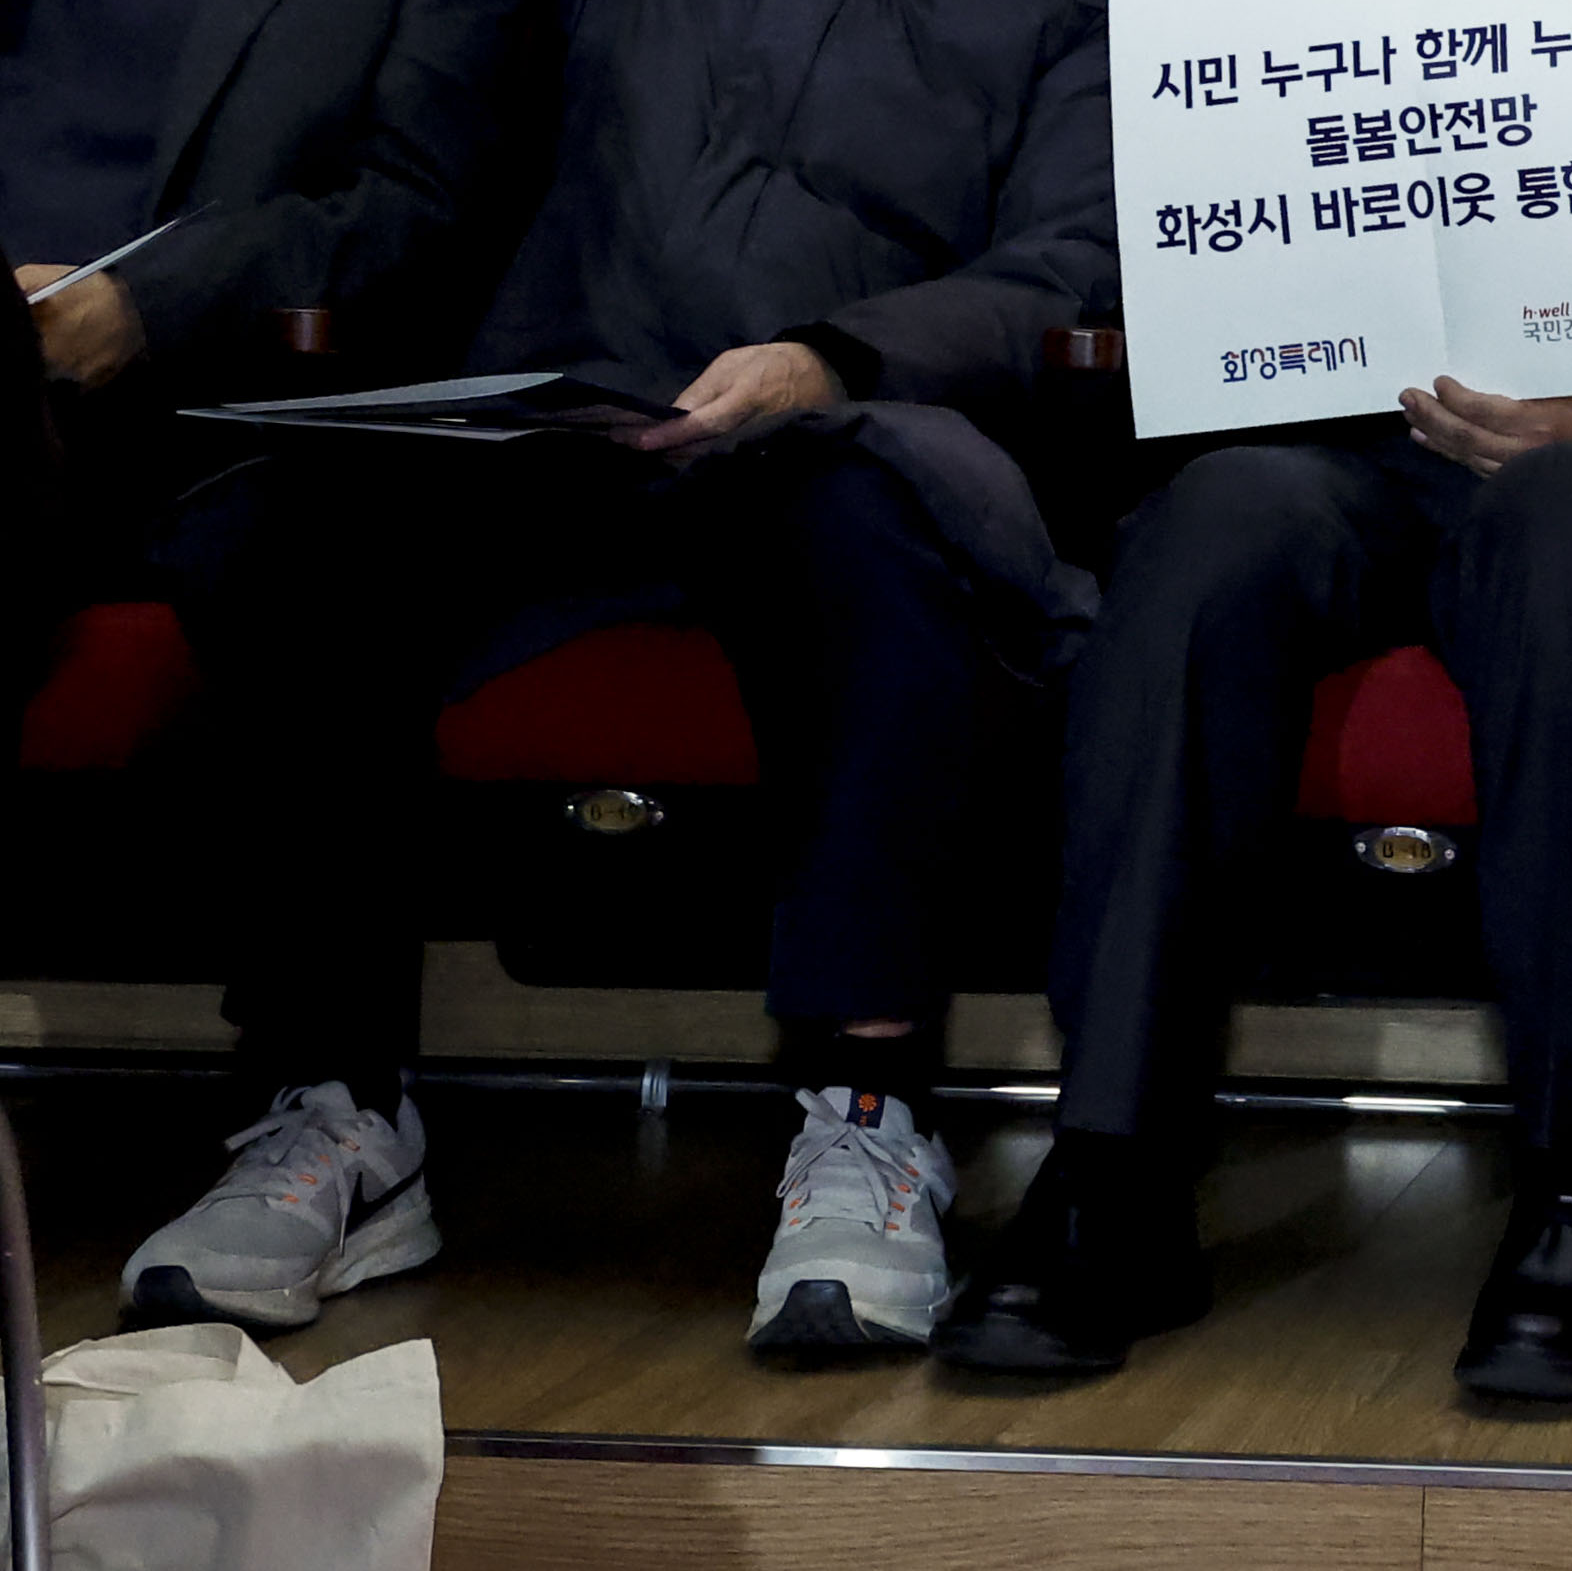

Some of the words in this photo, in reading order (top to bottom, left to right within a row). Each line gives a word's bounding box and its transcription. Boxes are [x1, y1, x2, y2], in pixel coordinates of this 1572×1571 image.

[1152, 54, 1239, 109] 시민
[1261, 35, 1397, 99] 누구나
[1415, 22, 1508, 81] 함께
[1305, 93, 1537, 167] 돌봄안전망
[1155, 194, 1292, 256] 화성시
[1311, 172, 1496, 238] 바로이웃
[1220, 335, 1367, 383] 화성특례시
